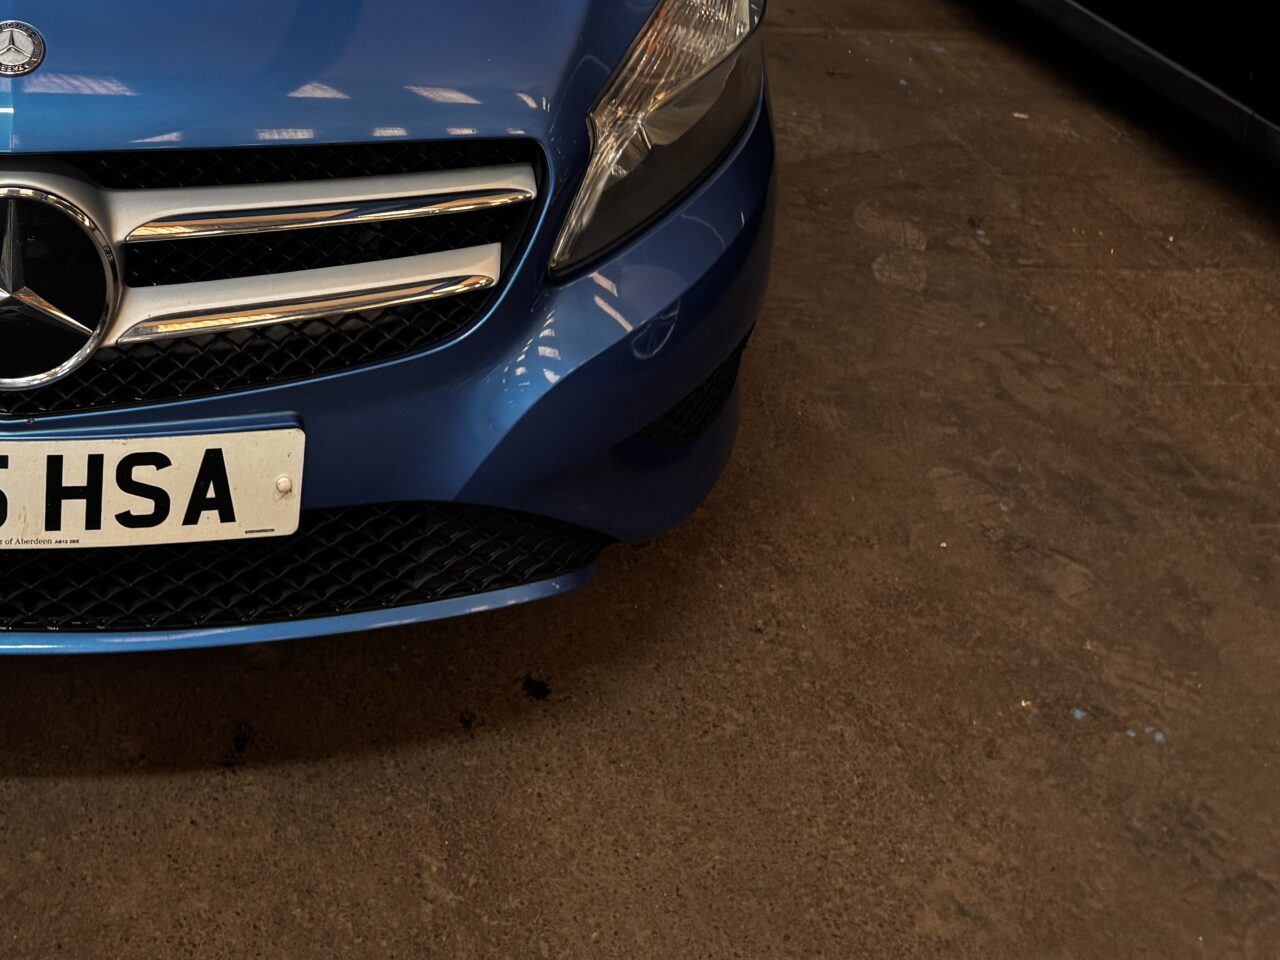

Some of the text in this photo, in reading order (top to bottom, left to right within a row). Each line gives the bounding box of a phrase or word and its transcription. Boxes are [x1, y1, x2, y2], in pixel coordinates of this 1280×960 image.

[44, 448, 237, 531] HSA
[4, 537, 13, 545] of
[15, 537, 52, 545] Aberdeen
